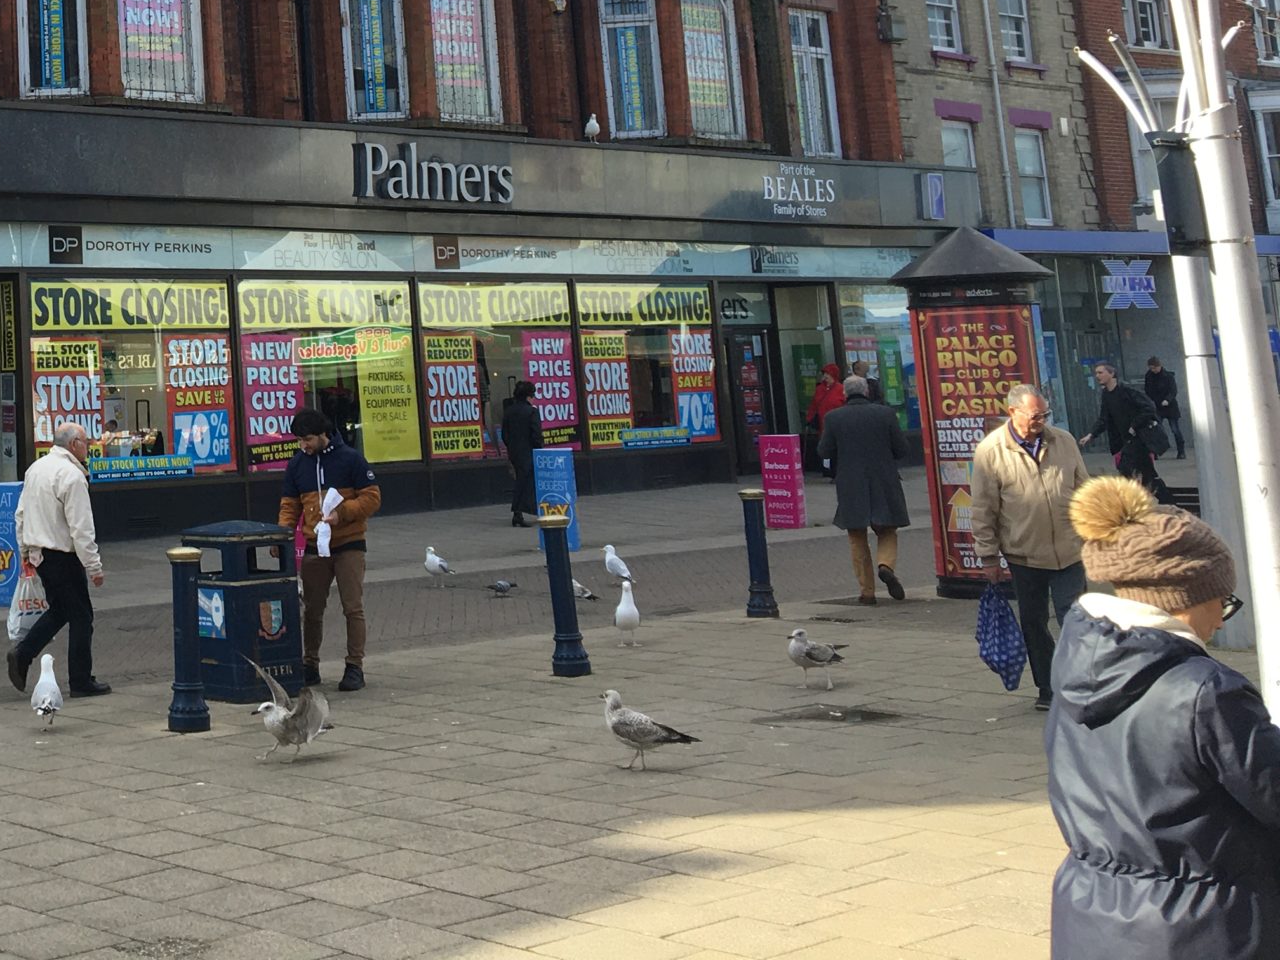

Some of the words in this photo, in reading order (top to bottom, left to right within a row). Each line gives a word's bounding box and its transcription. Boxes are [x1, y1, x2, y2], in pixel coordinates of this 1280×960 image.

[50, 14, 60, 24] IN
[126, 7, 179, 29] NOW!
[436, 19, 473, 37] CUTS
[51, 27, 61, 56] STORE
[435, 39, 478, 58] NOW!
[52, 59, 62, 85] NOW!
[360, 141, 514, 204] Palmers
[780, 163, 795, 175] Part
[794, 164, 804, 176] of
[803, 165, 815, 176] the
[762, 175, 835, 203] BEALES
[773, 203, 797, 218] Family
[796, 204, 805, 216] of
[805, 205, 827, 217] Stores
[52, 237, 78, 253] DP
[85, 240, 150, 252] DOROTHY
[154, 242, 212, 254] PERKINS
[321, 232, 353, 250] HAIR
[357, 240, 376, 251] and
[592, 241, 665, 257] RESTAURANT
[665, 248, 680, 257] and
[273, 249, 329, 268] BEAUTY
[331, 250, 378, 269] SALON
[437, 246, 456, 259] DP
[461, 248, 510, 258] DOROTHY
[513, 250, 557, 259] PERKINS
[761, 246, 799, 264] Palmers
[607, 257, 644, 273] COFFEE
[4, 283, 12, 316] STORE
[34, 288, 113, 326] STORE
[120, 287, 228, 326] CLOSING!
[242, 289, 311, 324] STORE
[317, 289, 410, 324] CLOSING!
[423, 290, 481, 323] STORE
[487, 290, 569, 323] CLOSING!
[581, 291, 633, 322] STORE
[637, 291, 710, 322] CLOSING!
[960, 323, 984, 333] THE
[6, 319, 14, 368] CLOSING!
[427, 338, 442, 348] ALL
[444, 338, 472, 348] STOCK
[530, 338, 564, 355] NEW
[584, 337, 597, 346] ALL
[599, 336, 624, 345] STOCK
[671, 334, 711, 355] STORE
[936, 335, 1015, 351] PALACE
[36, 345, 57, 355] ALL
[61, 344, 97, 354] STOCK
[168, 338, 227, 367] STORE
[250, 342, 292, 361] NEW
[427, 348, 473, 360] REDUCED!
[584, 346, 625, 357] REDUCED!
[673, 357, 713, 373] CLOSING
[937, 349, 1018, 369] BINGO
[246, 366, 299, 385] PRICE
[528, 360, 572, 377] PRICE
[957, 369, 990, 379] CLUB
[992, 368, 1000, 378] &
[169, 366, 228, 388] CLOSING
[368, 372, 406, 382] FIXTURES,
[428, 365, 477, 398] STORE
[585, 362, 629, 392] STORE
[678, 376, 703, 388] SAVE
[36, 375, 101, 412] STORE
[175, 390, 212, 406] SAVE
[363, 385, 404, 396] FURNITURE
[407, 385, 412, 393] &
[534, 381, 570, 399] CUTS
[251, 390, 297, 411] CUTS
[366, 398, 411, 409] EQUIPMENT
[586, 393, 630, 416] CLOSING
[372, 413, 388, 422] FOR
[389, 411, 407, 421] SALE
[429, 398, 480, 423] CLOSING
[591, 422, 632, 430] EVERYTHING
[703, 415, 715, 429] OFF
[936, 420, 951, 428] THE
[952, 417, 985, 428] ONLY
[432, 428, 479, 439] EVERYTHING
[592, 431, 615, 442] MUST
[937, 429, 984, 443] BINGO
[213, 439, 229, 457] OFF
[251, 446, 270, 455] WHEN
[271, 444, 282, 452] IT'S
[434, 439, 459, 451] MUST
[463, 438, 481, 449] GO!
[938, 443, 969, 452] CLUB
[92, 461, 109, 471] NEW
[111, 460, 134, 470] STOCK
[136, 459, 145, 468] IN
[147, 458, 169, 468] STORE
[171, 457, 193, 467] NOW!
[262, 453, 274, 462] IT'S
[275, 450, 294, 460] GONE!
[536, 455, 567, 469] GREAT
[764, 461, 790, 470] Barbour
